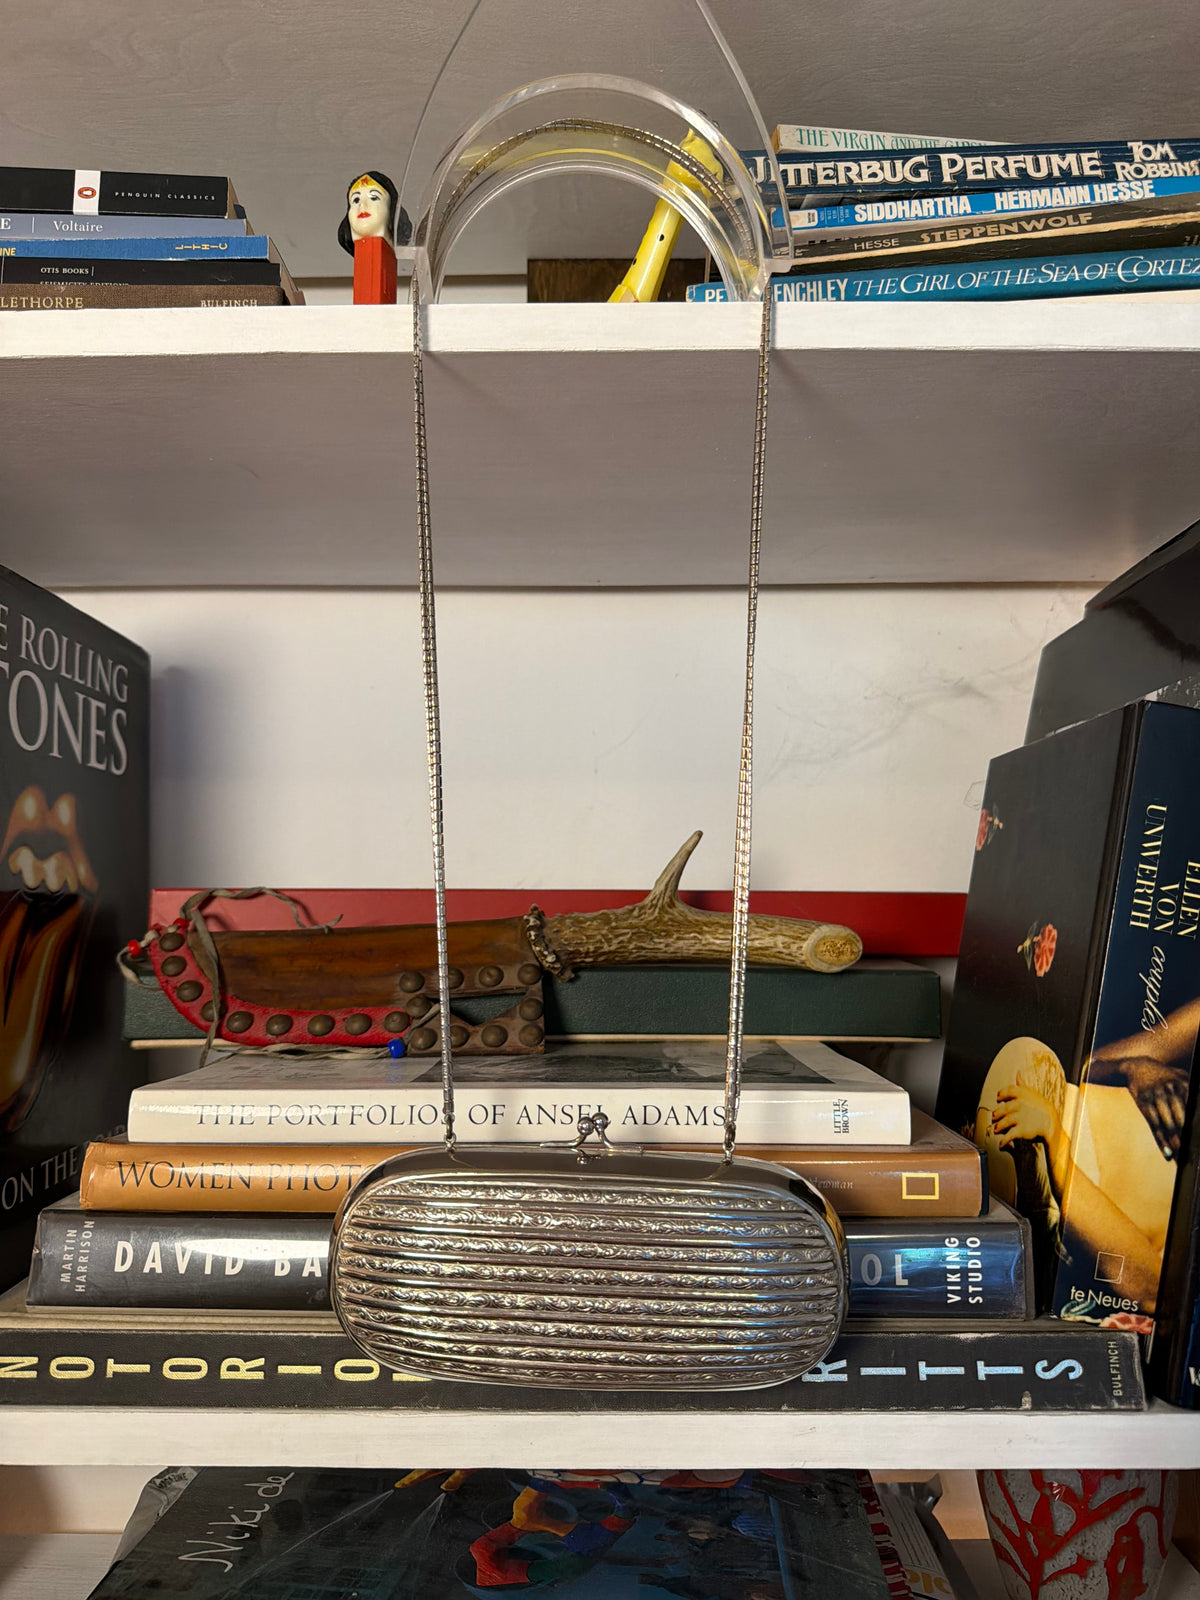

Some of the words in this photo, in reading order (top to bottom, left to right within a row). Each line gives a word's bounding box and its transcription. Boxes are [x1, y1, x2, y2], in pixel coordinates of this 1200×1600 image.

[795, 127, 829, 148] THE
[830, 129, 886, 151] VIRGIN
[1127, 140, 1179, 163] TOM
[749, 154, 931, 187] JITTERBUG
[937, 151, 1103, 184] PERFUME
[1112, 160, 1200, 182] ROBBINS
[114, 191, 161, 199] PENGUIN
[167, 193, 216, 201] CLASSICS
[854, 195, 972, 223] SIDDHARTHA
[994, 184, 1091, 211] HERMANN
[1093, 179, 1156, 204] HESSE
[52, 219, 104, 232] Voltaire
[853, 237, 900, 251] HESSE
[919, 213, 1093, 244] STEPPENWOLF
[175, 242, 228, 251] LITHIC
[40, 266, 60, 274] OTIS
[62, 267, 90, 275] BOOKS
[771, 277, 849, 302] ENCHLEY
[852, 276, 899, 297] THE
[900, 272, 955, 295] GIRL
[956, 271, 990, 289] OF
[990, 267, 1037, 287] THE
[1038, 262, 1080, 284] SEA
[1083, 262, 1117, 281] OF
[19, 613, 129, 704] ROLLING
[1129, 803, 1168, 931] UNWERTH
[1153, 881, 1180, 935] VON
[1177, 859, 1200, 940] ELLEN
[1138, 945, 1169, 1035] couples
[193, 1103, 256, 1126] THE
[467, 1103, 506, 1126] OF
[621, 1104, 727, 1127] ADAMS
[841, 1098, 850, 1135] BROWN
[1, 1166, 35, 1211] ON
[40, 1145, 80, 1191] THE
[116, 1159, 253, 1190] WOMEN
[267, 1163, 376, 1192] PHOT
[59, 1228, 78, 1284] MARTIN
[74, 1219, 95, 1293] HARRISON
[113, 1240, 245, 1277] DAVID
[944, 1236, 962, 1304] VIKING
[965, 1236, 983, 1304] STUDIO
[801, 1358, 1084, 1383] RITTS
[1107, 1340, 1123, 1397] BULFINCH
[177, 1502, 271, 1574] Niki
[242, 1471, 296, 1498] de
